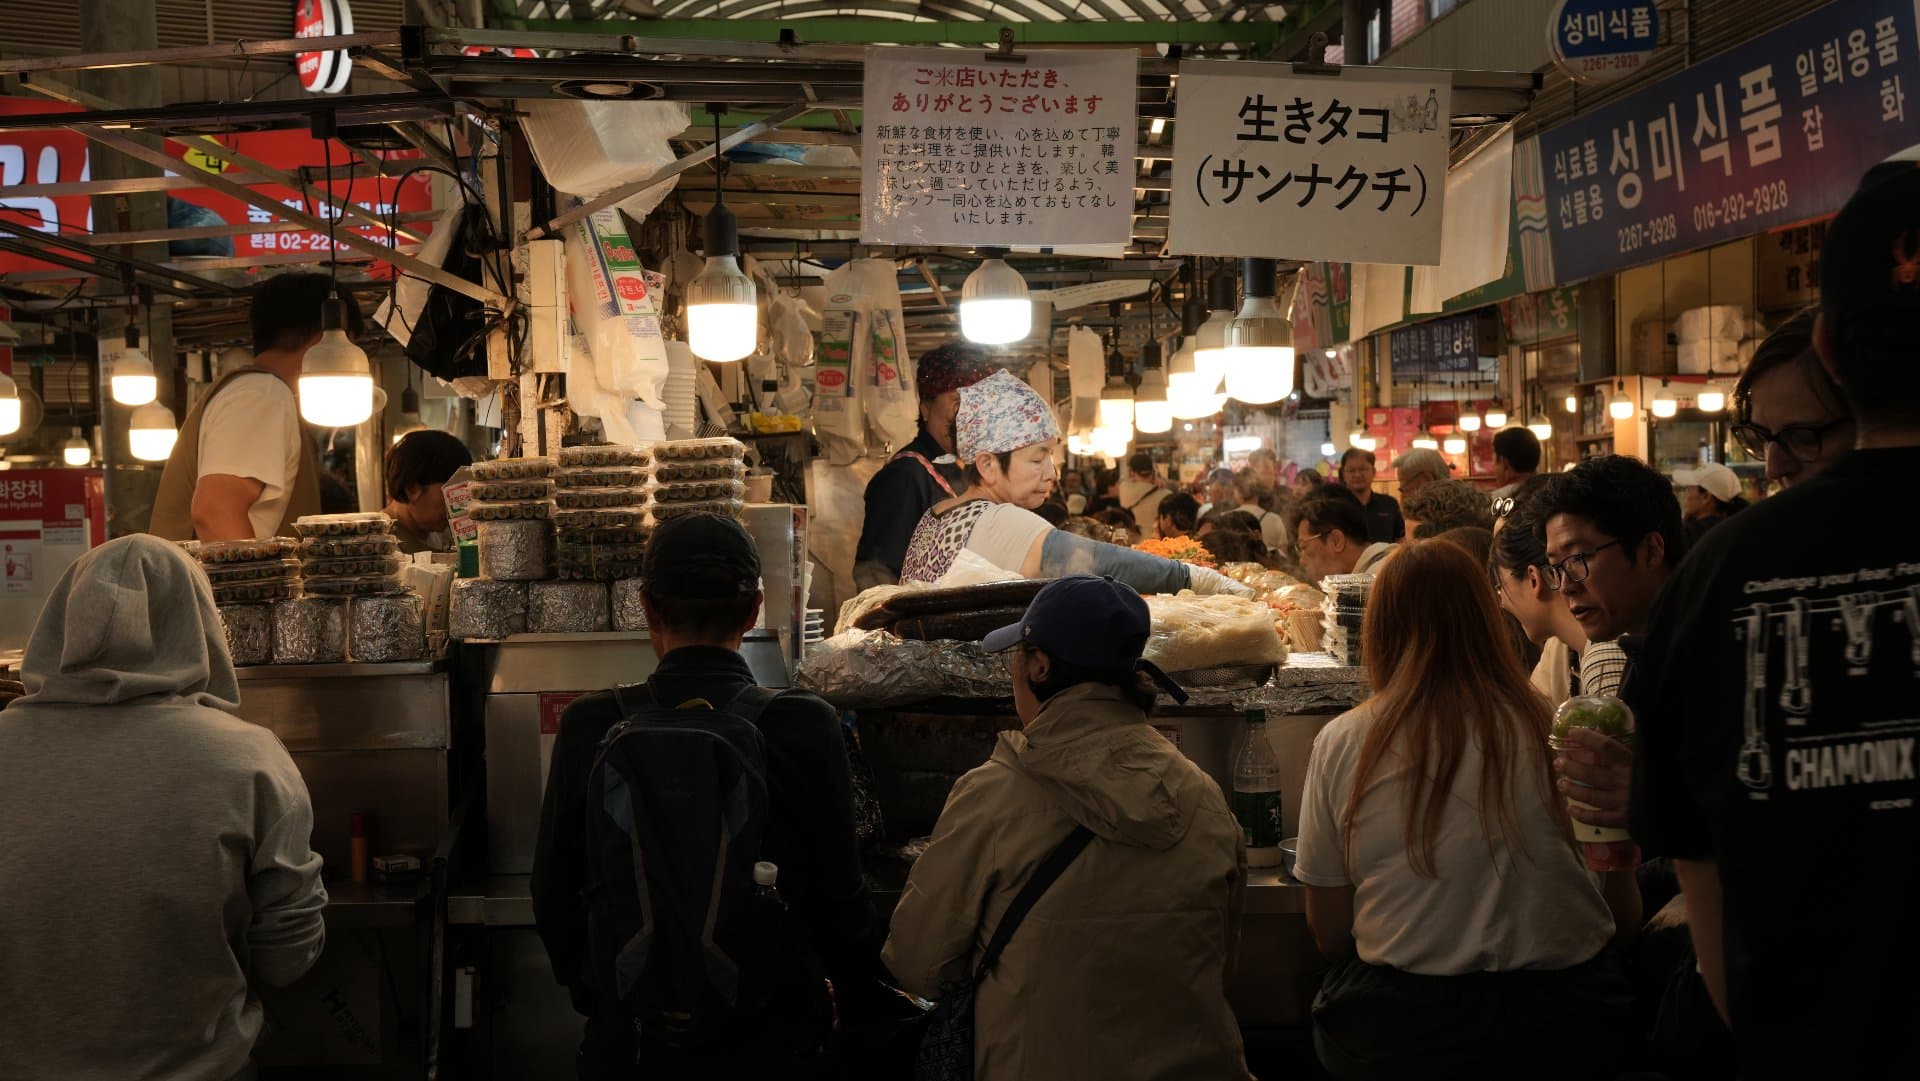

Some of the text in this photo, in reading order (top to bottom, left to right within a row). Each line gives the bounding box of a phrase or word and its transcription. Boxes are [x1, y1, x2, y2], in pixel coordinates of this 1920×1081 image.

[1563, 6, 1652, 45] 성미식품
[1583, 54, 1640, 71] 2267-2928
[1795, 15, 1899, 97] 일회용품
[892, 94, 1103, 115] ありがとうございます
[1236, 94, 1390, 145] 生きタコ
[1609, 63, 1783, 210] 성미식품
[1554, 138, 1599, 185] 식료품
[954, 211, 1034, 226] いたします。
[1559, 183, 1604, 230] 선물용
[1617, 179, 1789, 253] 2267-2928 016-292-2928
[251, 233, 276, 249] 본점
[1785, 737, 1916, 791] CHAMONIX
